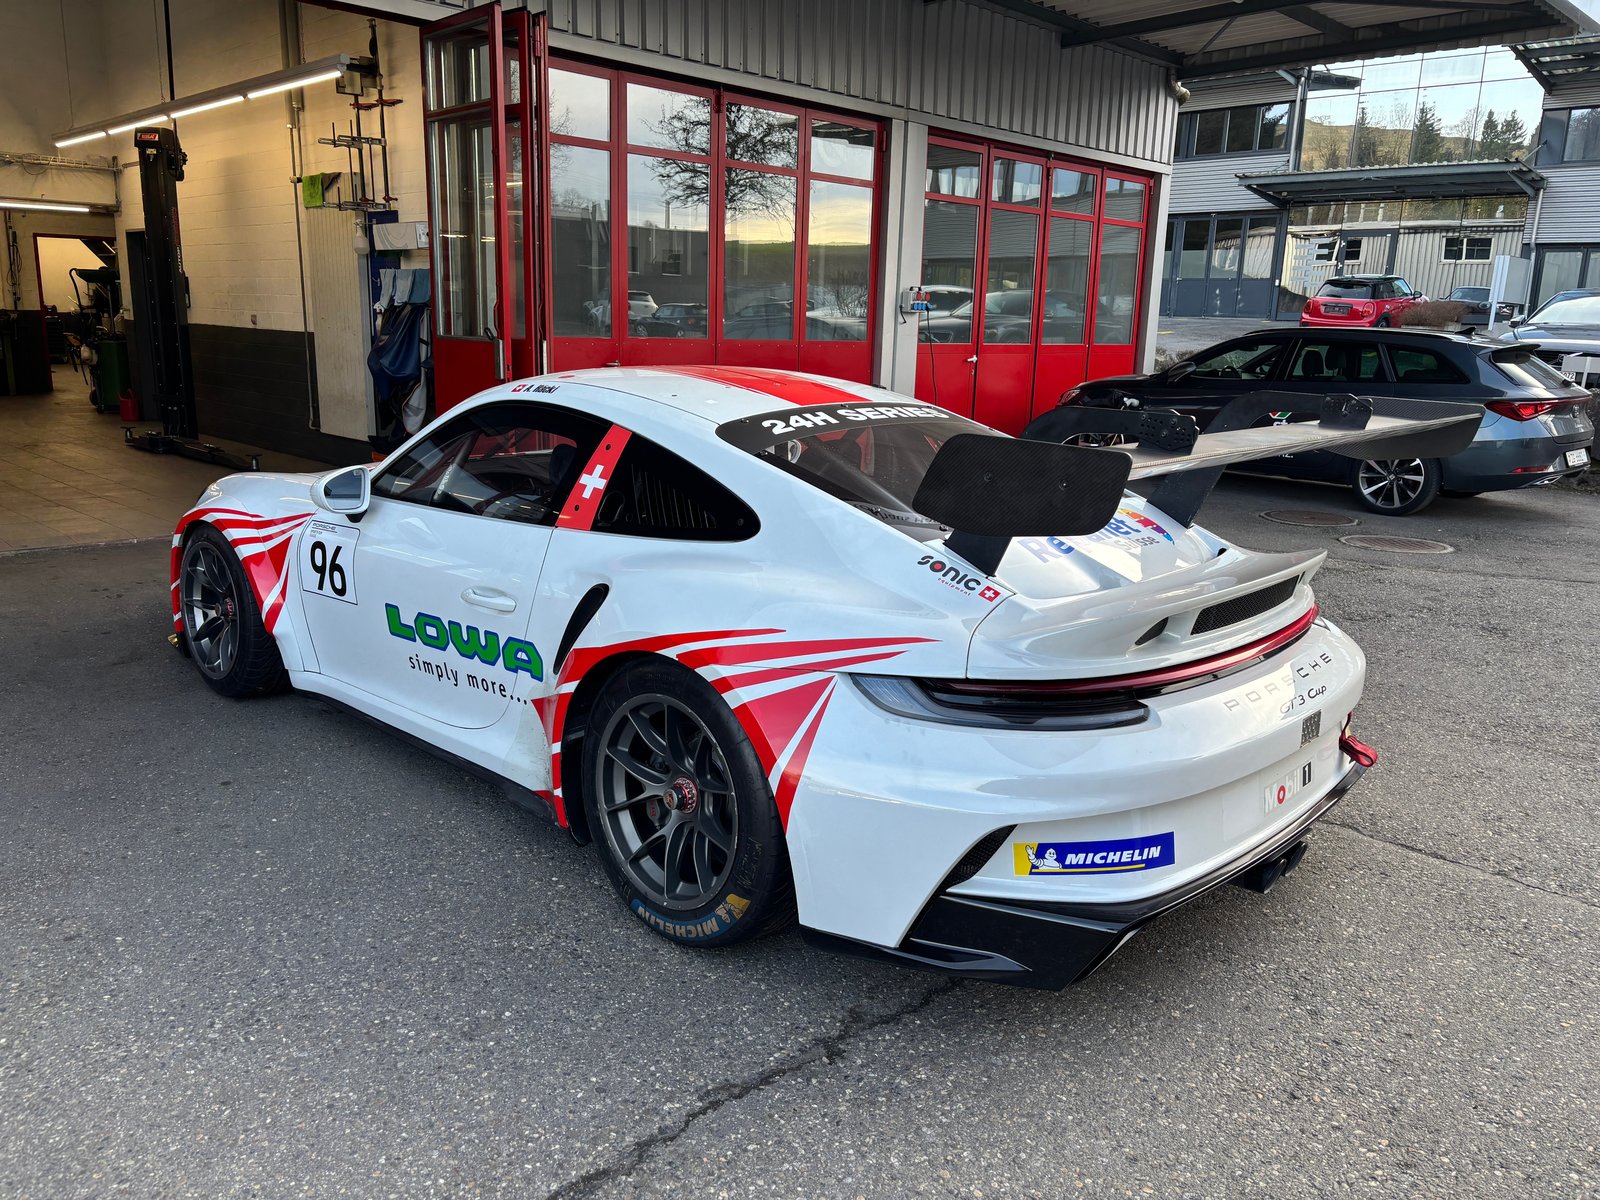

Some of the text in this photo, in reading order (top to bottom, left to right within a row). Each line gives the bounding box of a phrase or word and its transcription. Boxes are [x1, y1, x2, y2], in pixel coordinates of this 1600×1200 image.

[761, 406, 949, 435] 24H SERIES
[310, 541, 347, 597] 96
[385, 603, 543, 682] LOWA
[408, 653, 459, 687] simply
[1223, 653, 1332, 711] PORSCHE
[1307, 685, 1327, 699] Cup
[1264, 767, 1300, 813] Mobil
[1065, 845, 1161, 865] MICHELIN
[637, 906, 720, 938] MICHELIN
